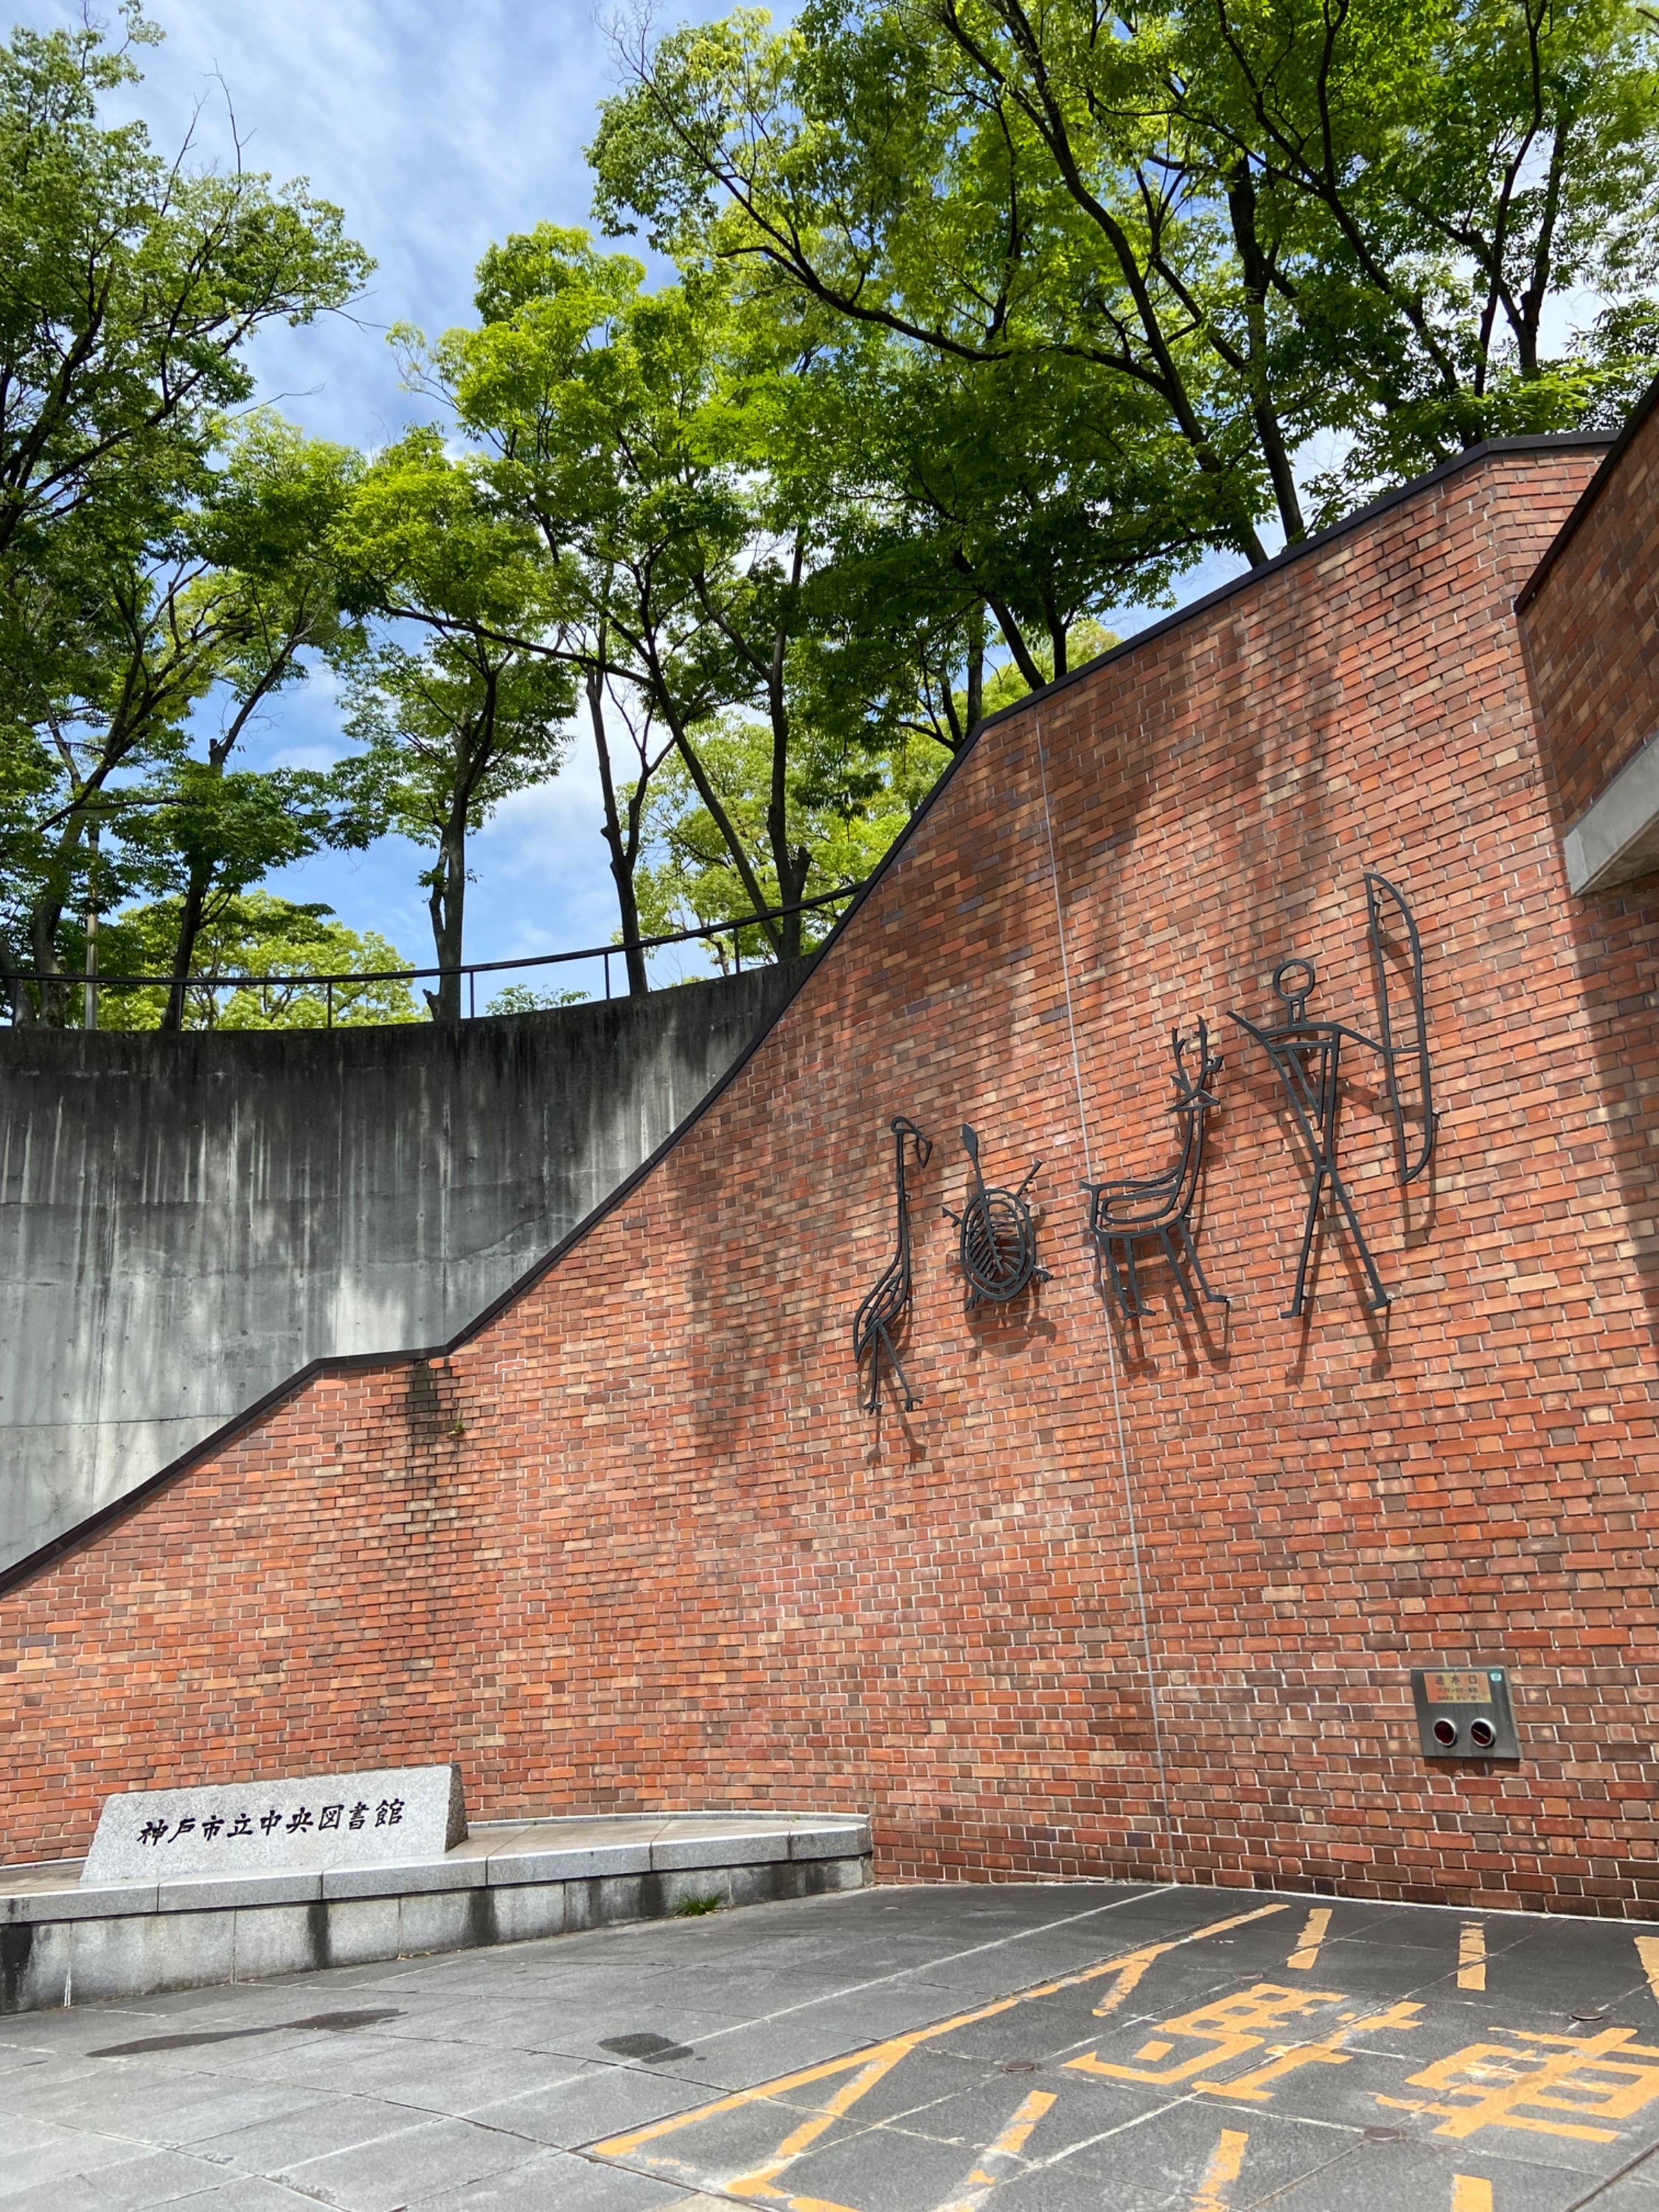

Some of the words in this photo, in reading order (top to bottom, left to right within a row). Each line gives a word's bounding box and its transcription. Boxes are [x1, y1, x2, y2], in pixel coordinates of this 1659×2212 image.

[136, 1798, 406, 1846] 神戸市立中央図書館
[1062, 1983, 1659, 2143] 駐車
